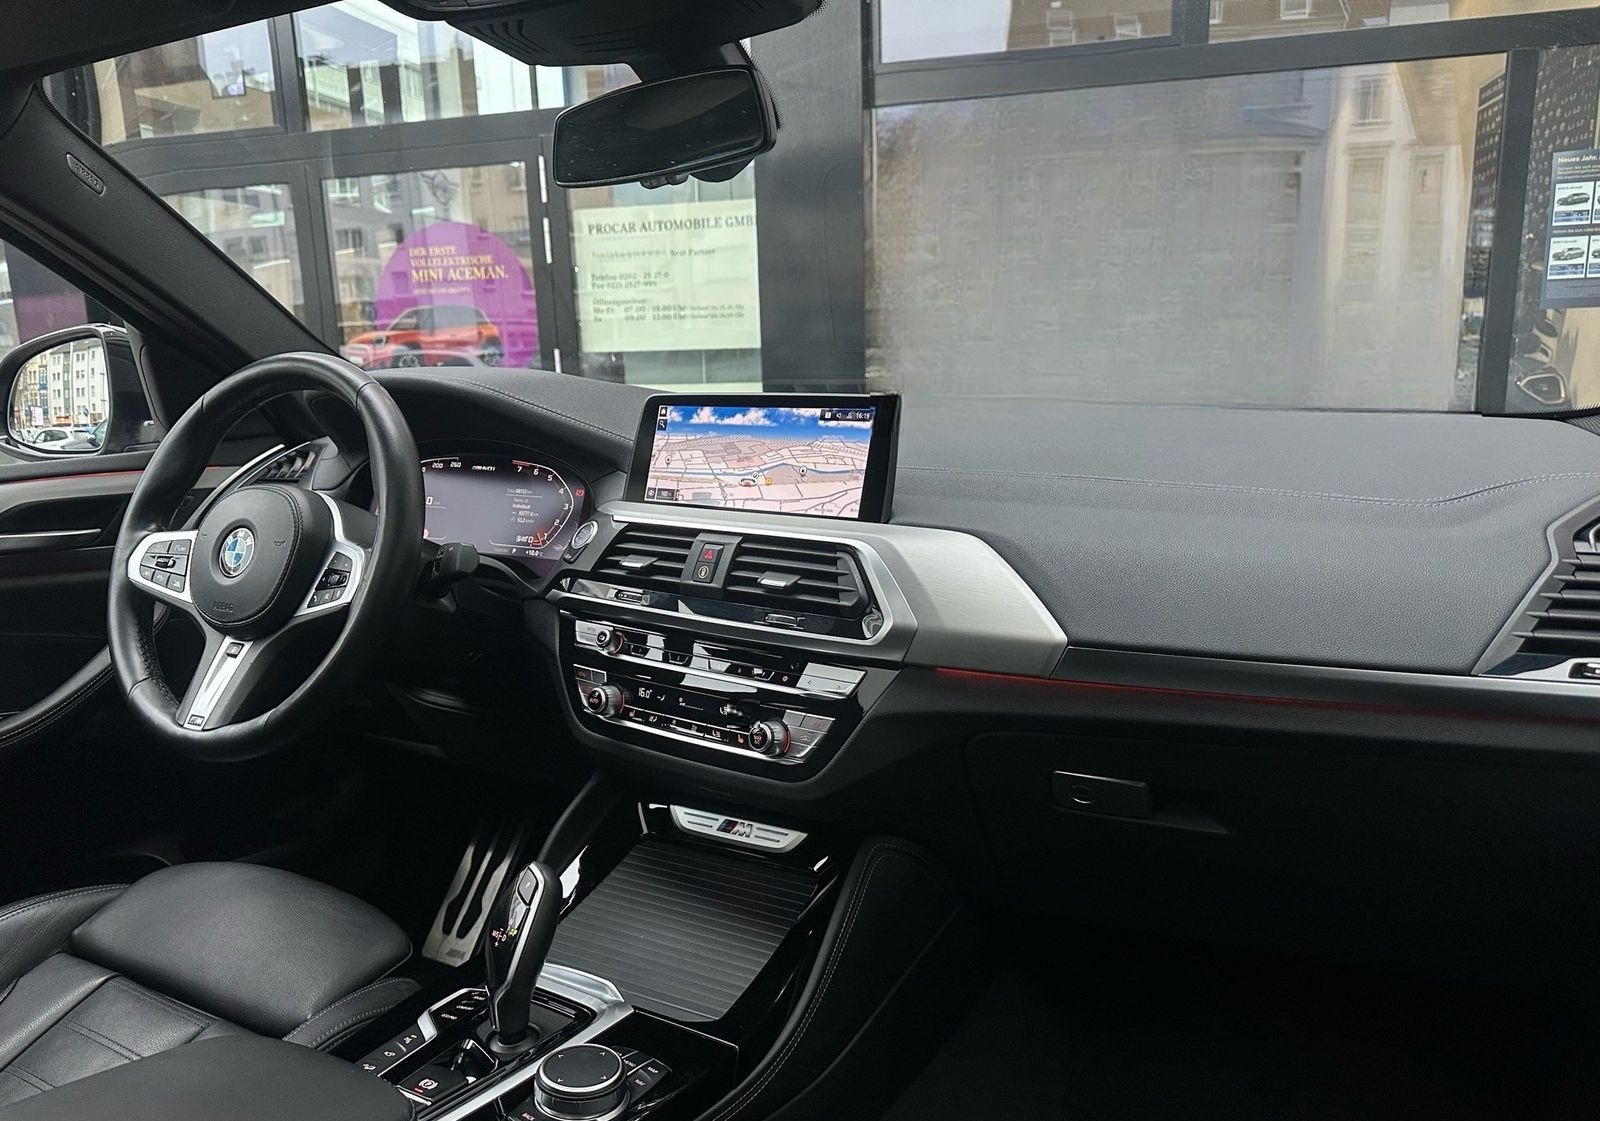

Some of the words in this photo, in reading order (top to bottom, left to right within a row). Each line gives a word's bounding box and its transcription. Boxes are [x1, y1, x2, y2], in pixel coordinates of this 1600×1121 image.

[588, 222, 637, 235] PROCAR
[640, 216, 723, 233] AUTOMOBILE
[409, 246, 427, 257] DER
[411, 267, 444, 284] MINI
[447, 264, 509, 282] ACEMAN.
[517, 465, 523, 473] 7
[533, 468, 539, 476] 6
[547, 474, 553, 482] 5
